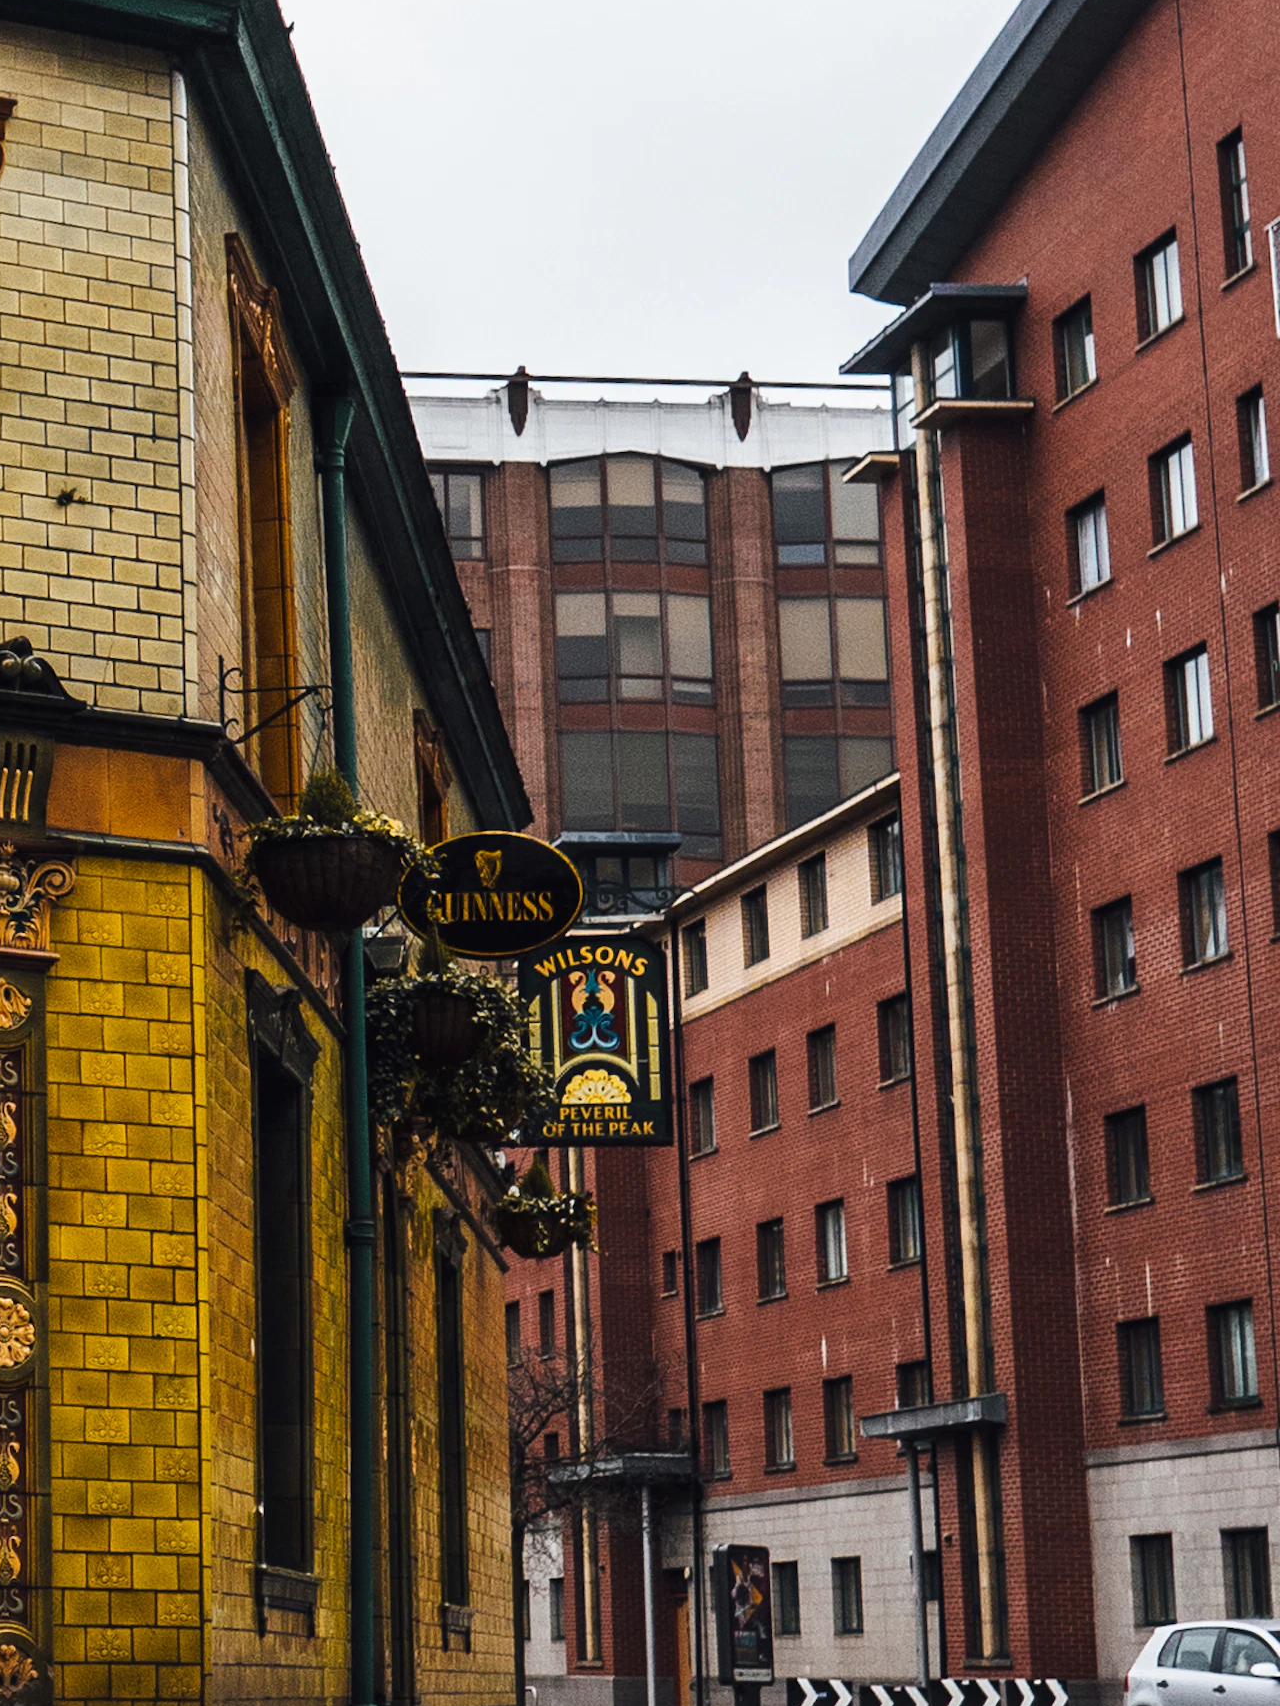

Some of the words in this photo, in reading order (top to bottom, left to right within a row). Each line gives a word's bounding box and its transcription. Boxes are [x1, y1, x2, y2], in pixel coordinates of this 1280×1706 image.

[427, 890, 554, 924] GUINNESS
[533, 945, 650, 979] WILSONS
[559, 1105, 633, 1121] PEVERIL
[542, 1121, 565, 1138] OF
[569, 1122, 605, 1137] THE
[608, 1120, 655, 1137] PEAK
